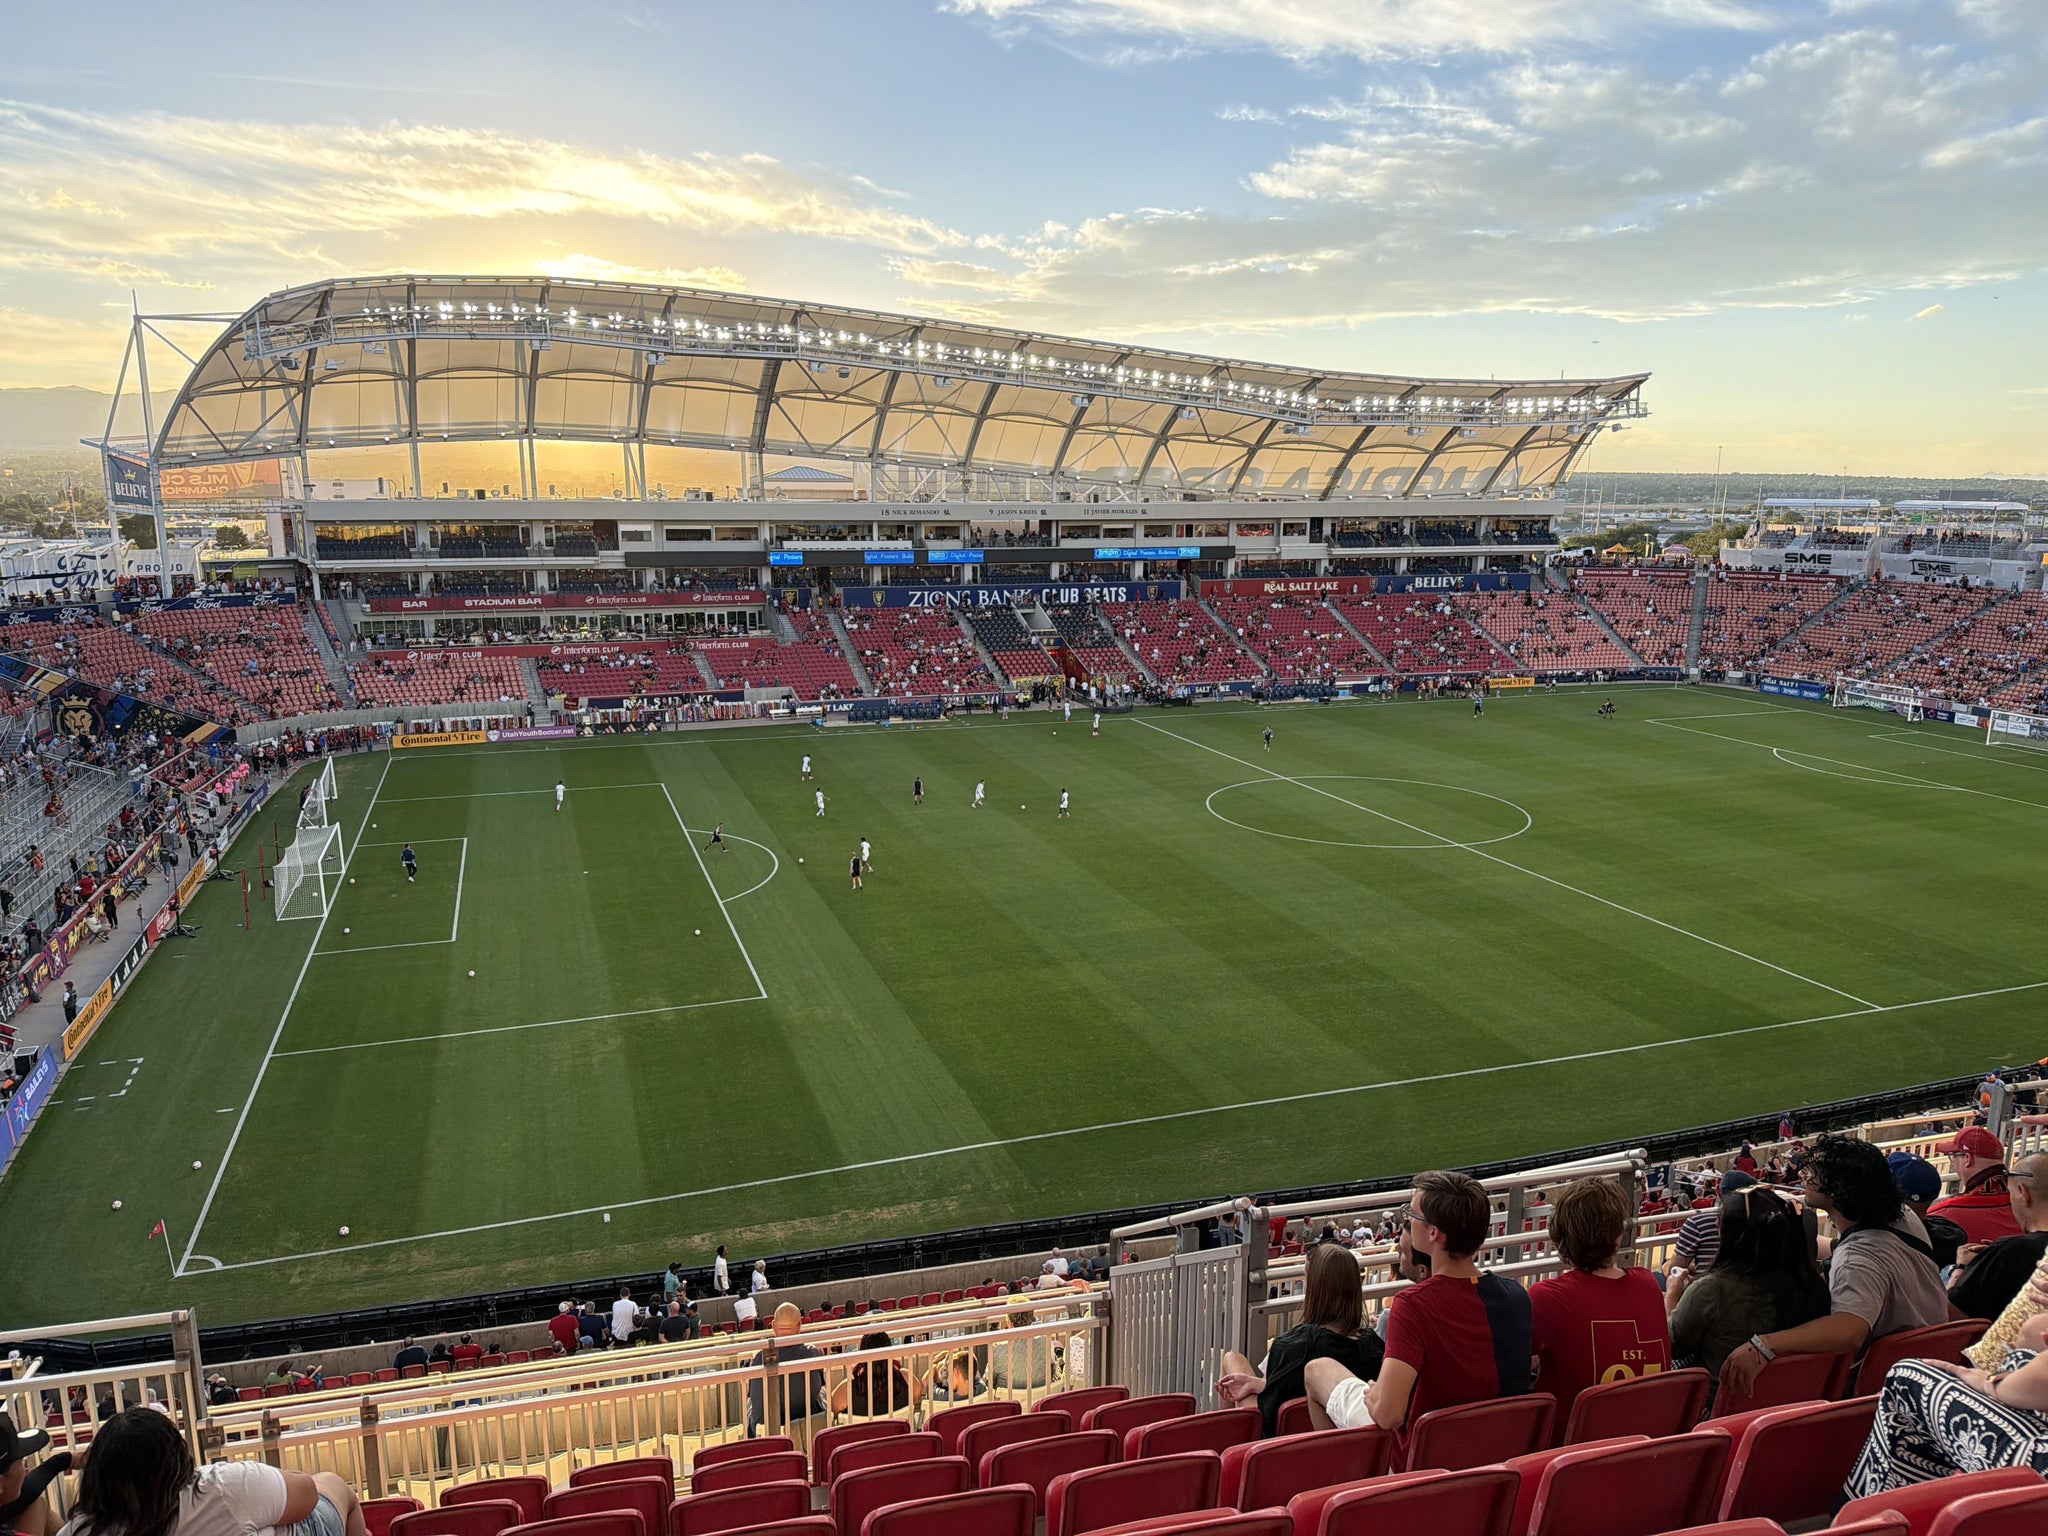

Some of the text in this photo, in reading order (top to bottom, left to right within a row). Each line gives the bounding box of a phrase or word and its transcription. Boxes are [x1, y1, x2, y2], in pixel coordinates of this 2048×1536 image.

[115, 482, 148, 499] BELIEVE
[881, 508, 890, 516] 18
[997, 508, 1018, 516] JASON
[1091, 508, 1111, 516] JAVIER
[1784, 552, 1832, 565] SME
[1917, 562, 1951, 573] SME
[1288, 582, 1312, 591] SALT
[1314, 581, 1339, 591] LAKE
[1415, 576, 1464, 588] BELIEVE
[464, 597, 542, 607] STADIUM BAR
[596, 596, 628, 604] Interform
[702, 593, 733, 602] Interform
[908, 590, 971, 607] ZIONS
[140, 601, 164, 613] Ford
[193, 598, 222, 609] Ford
[402, 600, 428, 608] BAR
[8, 612, 30, 625] Ford
[563, 644, 600, 655] Interform
[420, 650, 460, 661] Interfrm
[502, 728, 574, 738] UtahYouthSoccer.net
[401, 732, 480, 746] Continental Tire
[1656, 1172, 1665, 1186] 2
[1622, 1349, 1647, 1361] EST.
